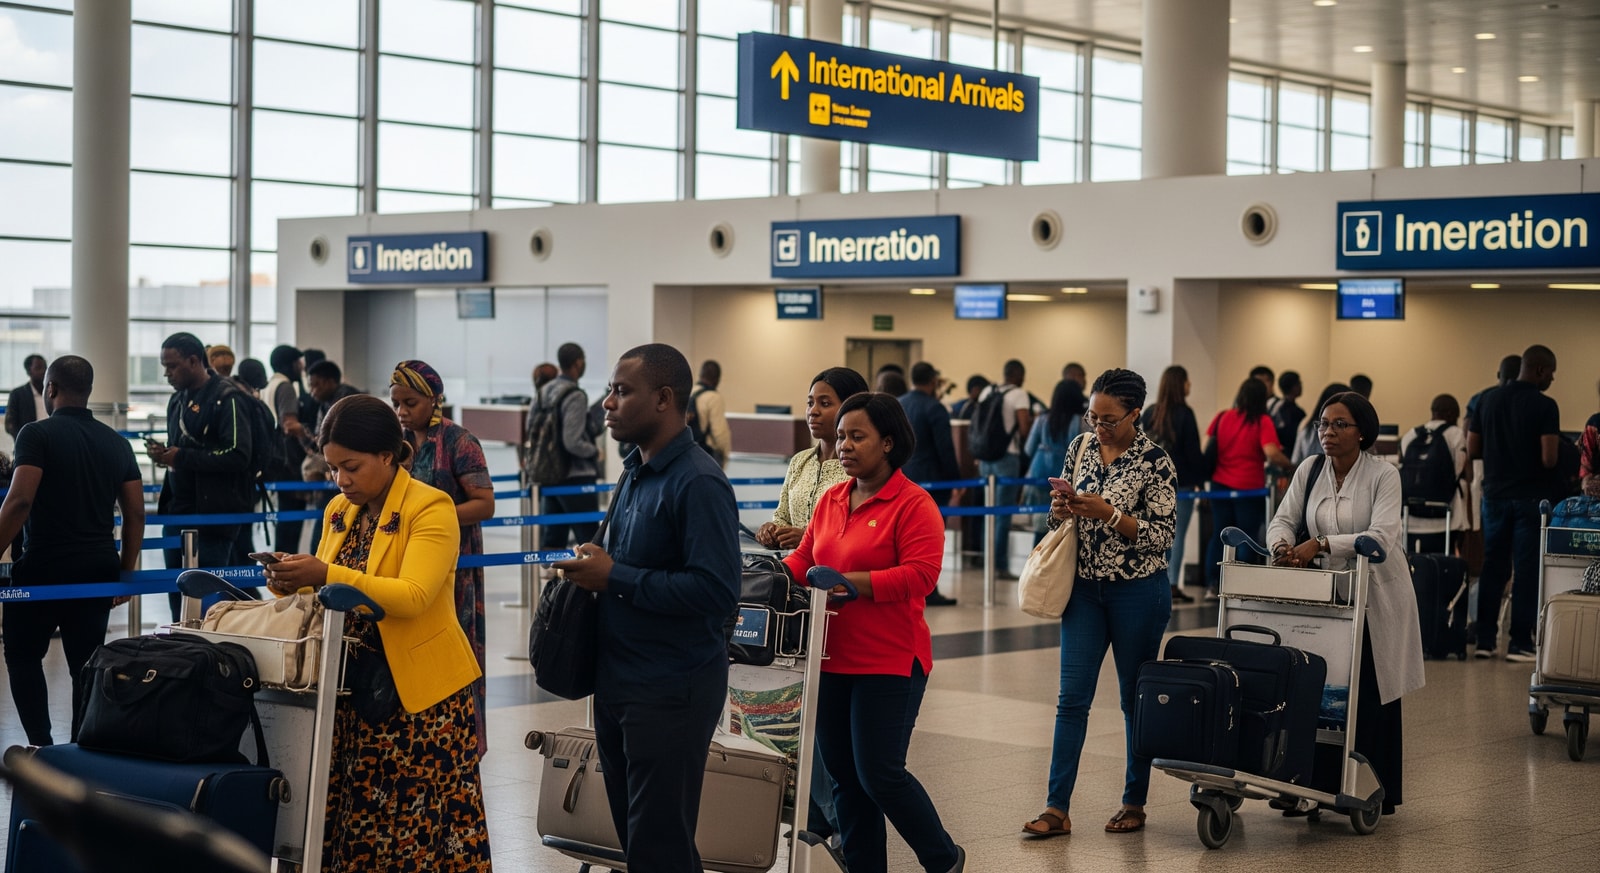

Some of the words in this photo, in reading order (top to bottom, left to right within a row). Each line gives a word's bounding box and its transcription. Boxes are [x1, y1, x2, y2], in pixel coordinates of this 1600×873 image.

[809, 51, 945, 102] International
[949, 73, 1025, 113] Arrivals
[808, 228, 941, 263] Imerration
[1395, 210, 1588, 251] Imeration
[376, 241, 473, 272] Imeration
